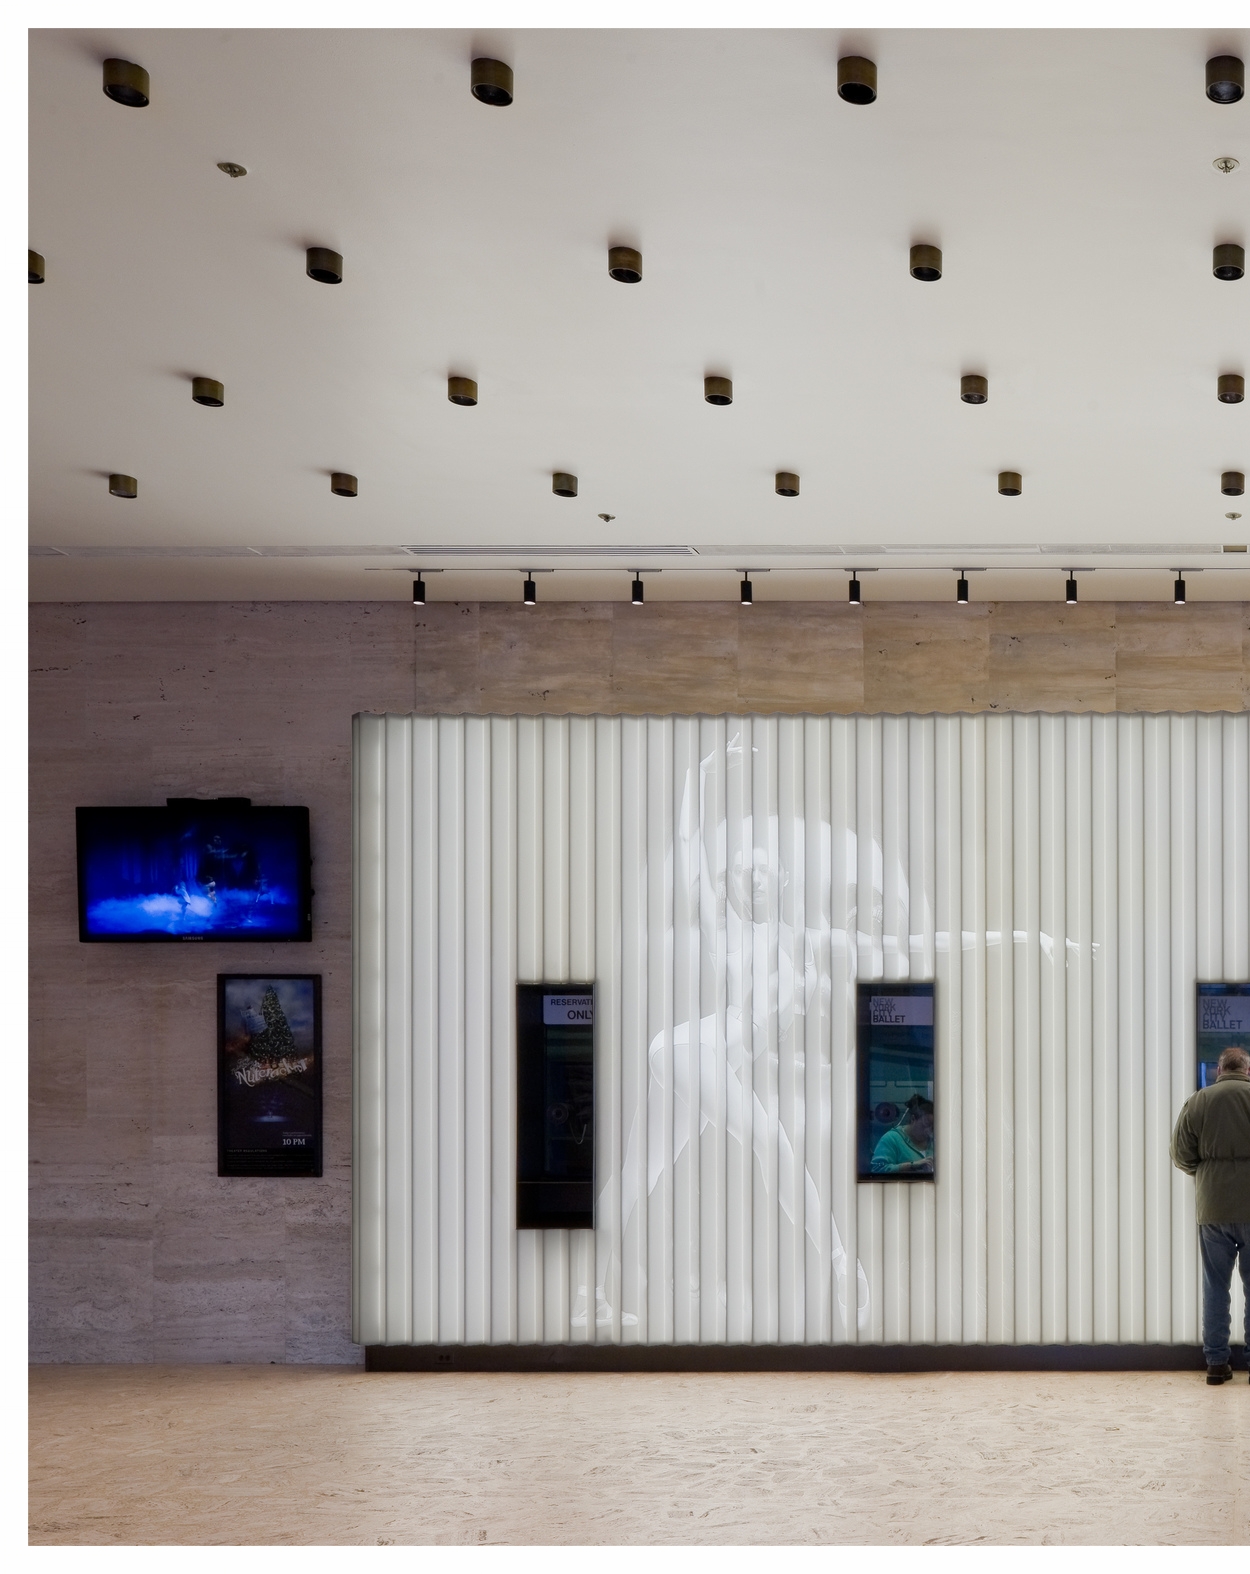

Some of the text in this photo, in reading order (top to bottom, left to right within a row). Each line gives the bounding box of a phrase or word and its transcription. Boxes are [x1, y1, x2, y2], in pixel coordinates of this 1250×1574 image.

[550, 998, 593, 1006] RESERVATI
[1202, 999, 1228, 1007] NEW
[873, 1004, 896, 1012] YORK
[1202, 1005, 1231, 1015] YORK
[873, 1015, 906, 1023] BALLET
[1202, 1012, 1227, 1021] CITY
[1202, 1020, 1243, 1029] BALLET
[282, 1138, 306, 1146] 10 PM
